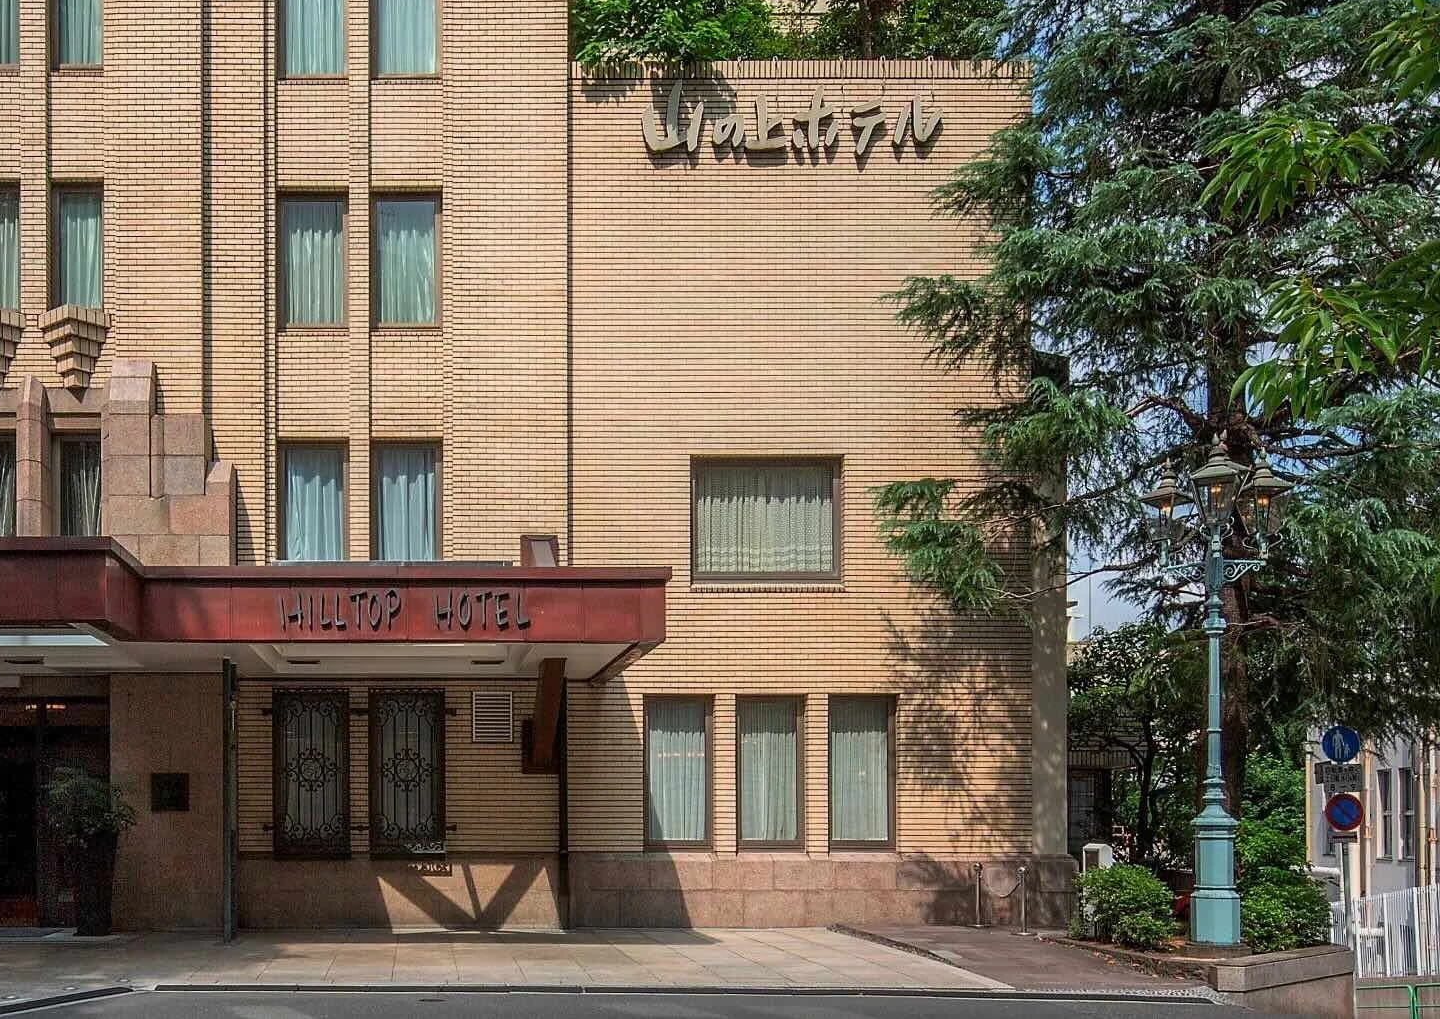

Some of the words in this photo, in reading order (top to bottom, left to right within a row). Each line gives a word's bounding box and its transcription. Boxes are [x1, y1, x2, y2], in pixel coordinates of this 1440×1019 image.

[641, 80, 944, 156] 山の上ホテル
[279, 589, 401, 631] HILLTOP
[434, 589, 530, 631] HOTEL
